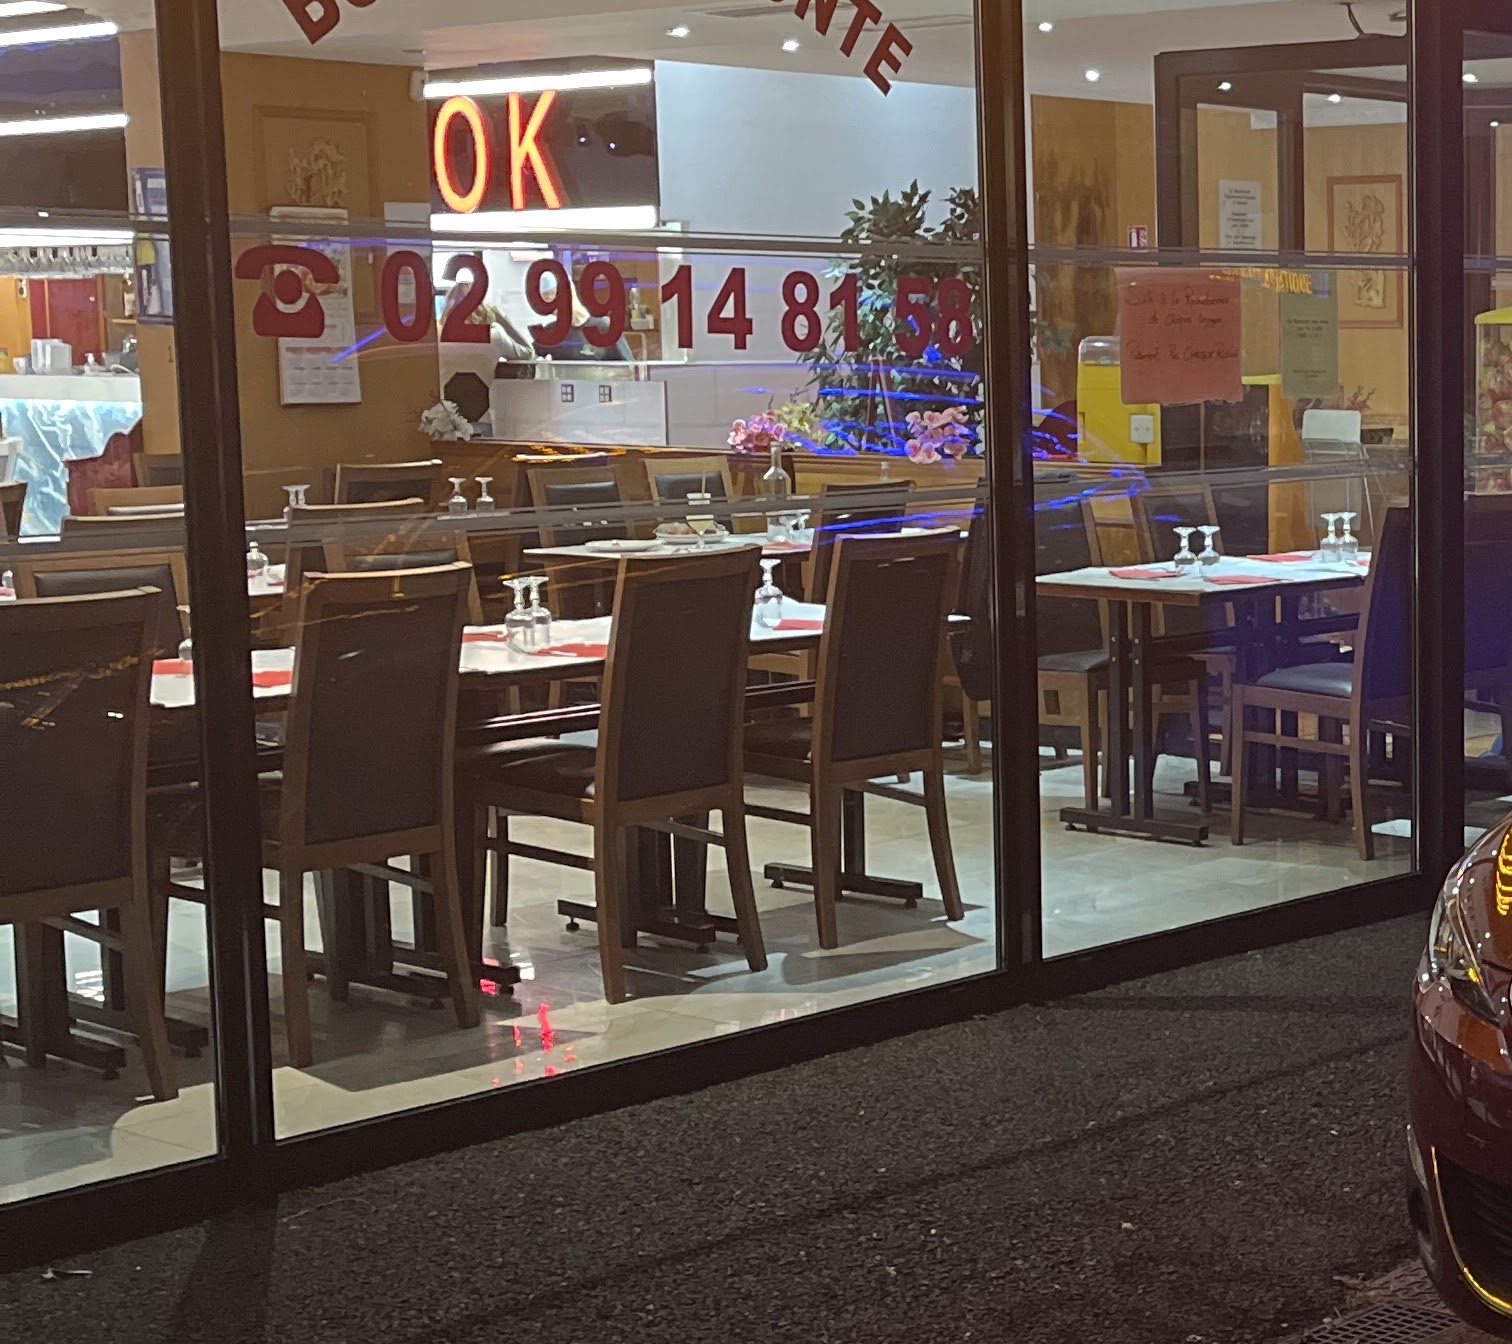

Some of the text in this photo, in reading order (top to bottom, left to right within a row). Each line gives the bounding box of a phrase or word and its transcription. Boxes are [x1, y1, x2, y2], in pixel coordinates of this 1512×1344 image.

[433, 89, 563, 215] OK
[381, 249, 975, 357] 02 99 14 81 58
